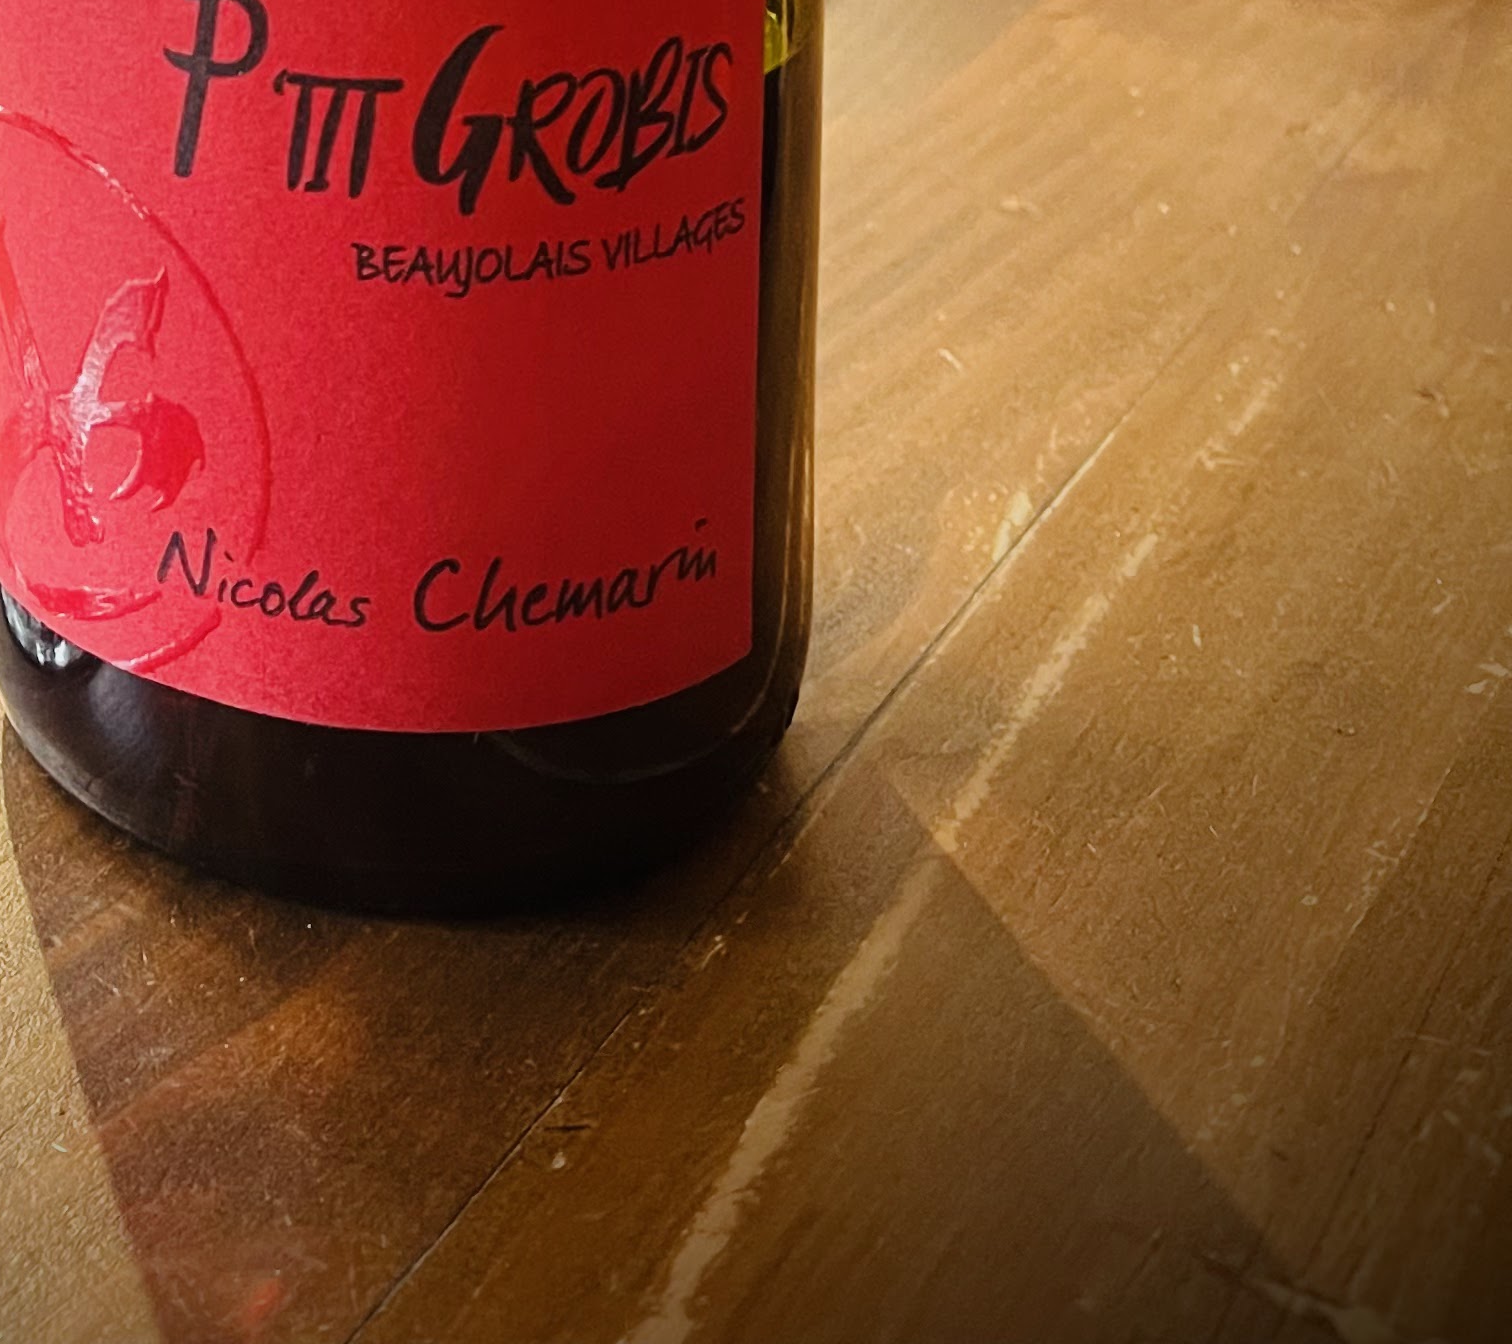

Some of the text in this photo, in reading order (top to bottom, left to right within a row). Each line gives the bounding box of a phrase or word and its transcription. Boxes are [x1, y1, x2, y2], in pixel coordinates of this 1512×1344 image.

[351, 197, 746, 299] BEAUJOLAIS VILLAGES
[156, 517, 718, 633] Nicolas Chemarin
